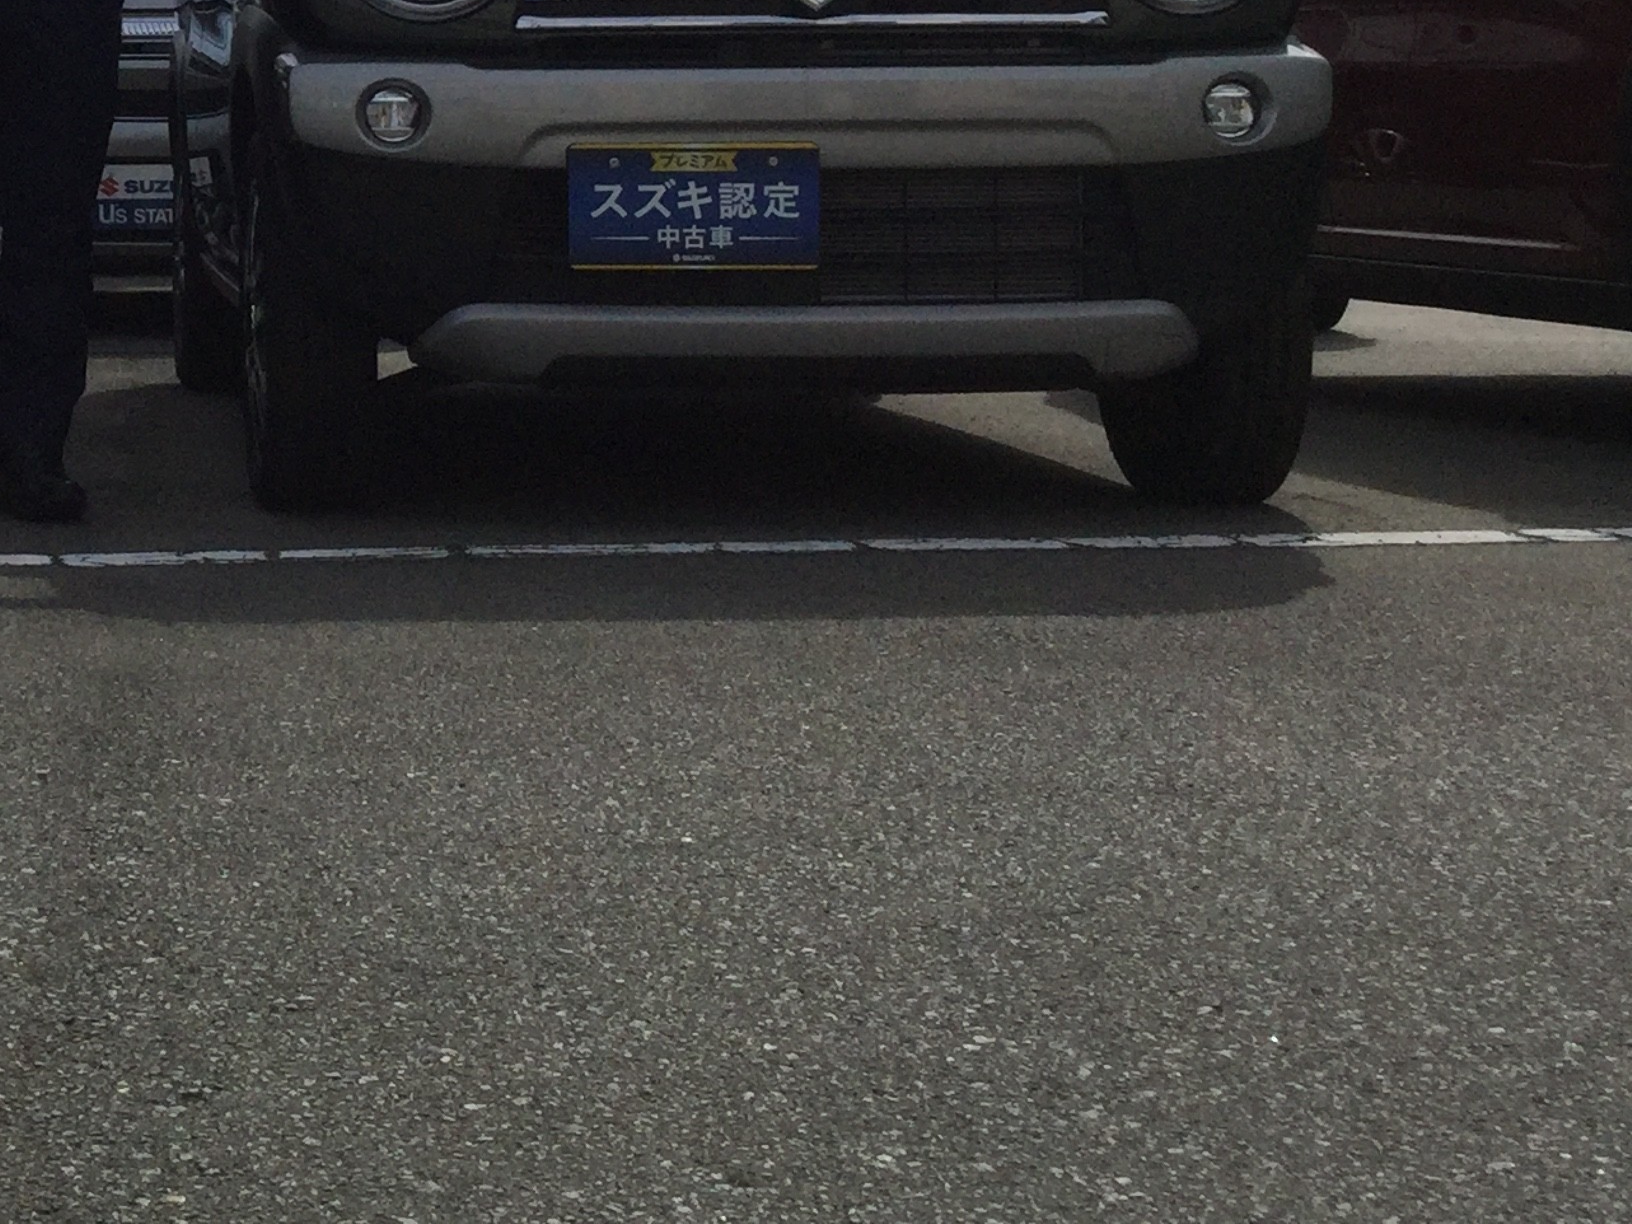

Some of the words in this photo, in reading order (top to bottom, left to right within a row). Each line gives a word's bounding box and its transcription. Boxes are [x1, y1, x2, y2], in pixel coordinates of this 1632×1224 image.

[659, 151, 729, 170] プレミアム
[124, 180, 173, 194] SUZ
[590, 178, 801, 221] スズキ認定
[657, 224, 735, 250] 中古車
